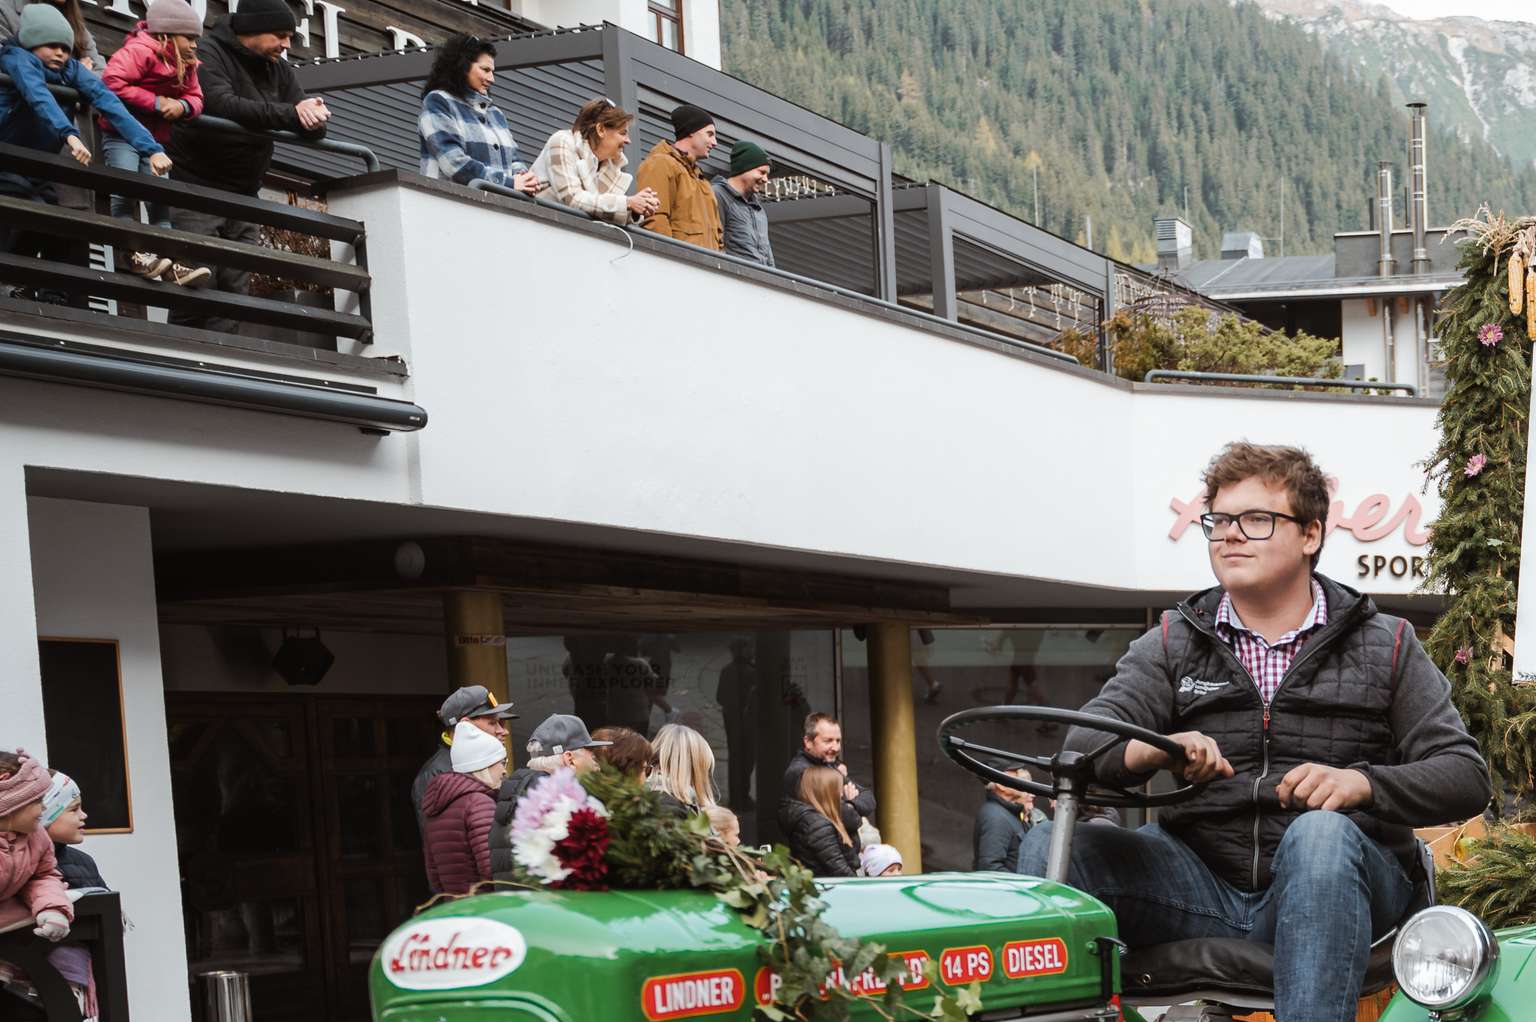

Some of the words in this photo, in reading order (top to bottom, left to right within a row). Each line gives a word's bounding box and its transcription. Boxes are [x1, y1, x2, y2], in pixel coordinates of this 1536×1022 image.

[1358, 554, 1425, 578] SPOR
[390, 931, 513, 973] Lindner
[653, 976, 735, 1014] LINDNER
[943, 954, 962, 979] 14
[967, 952, 990, 976] PS
[1008, 943, 1064, 974] DIESEL
